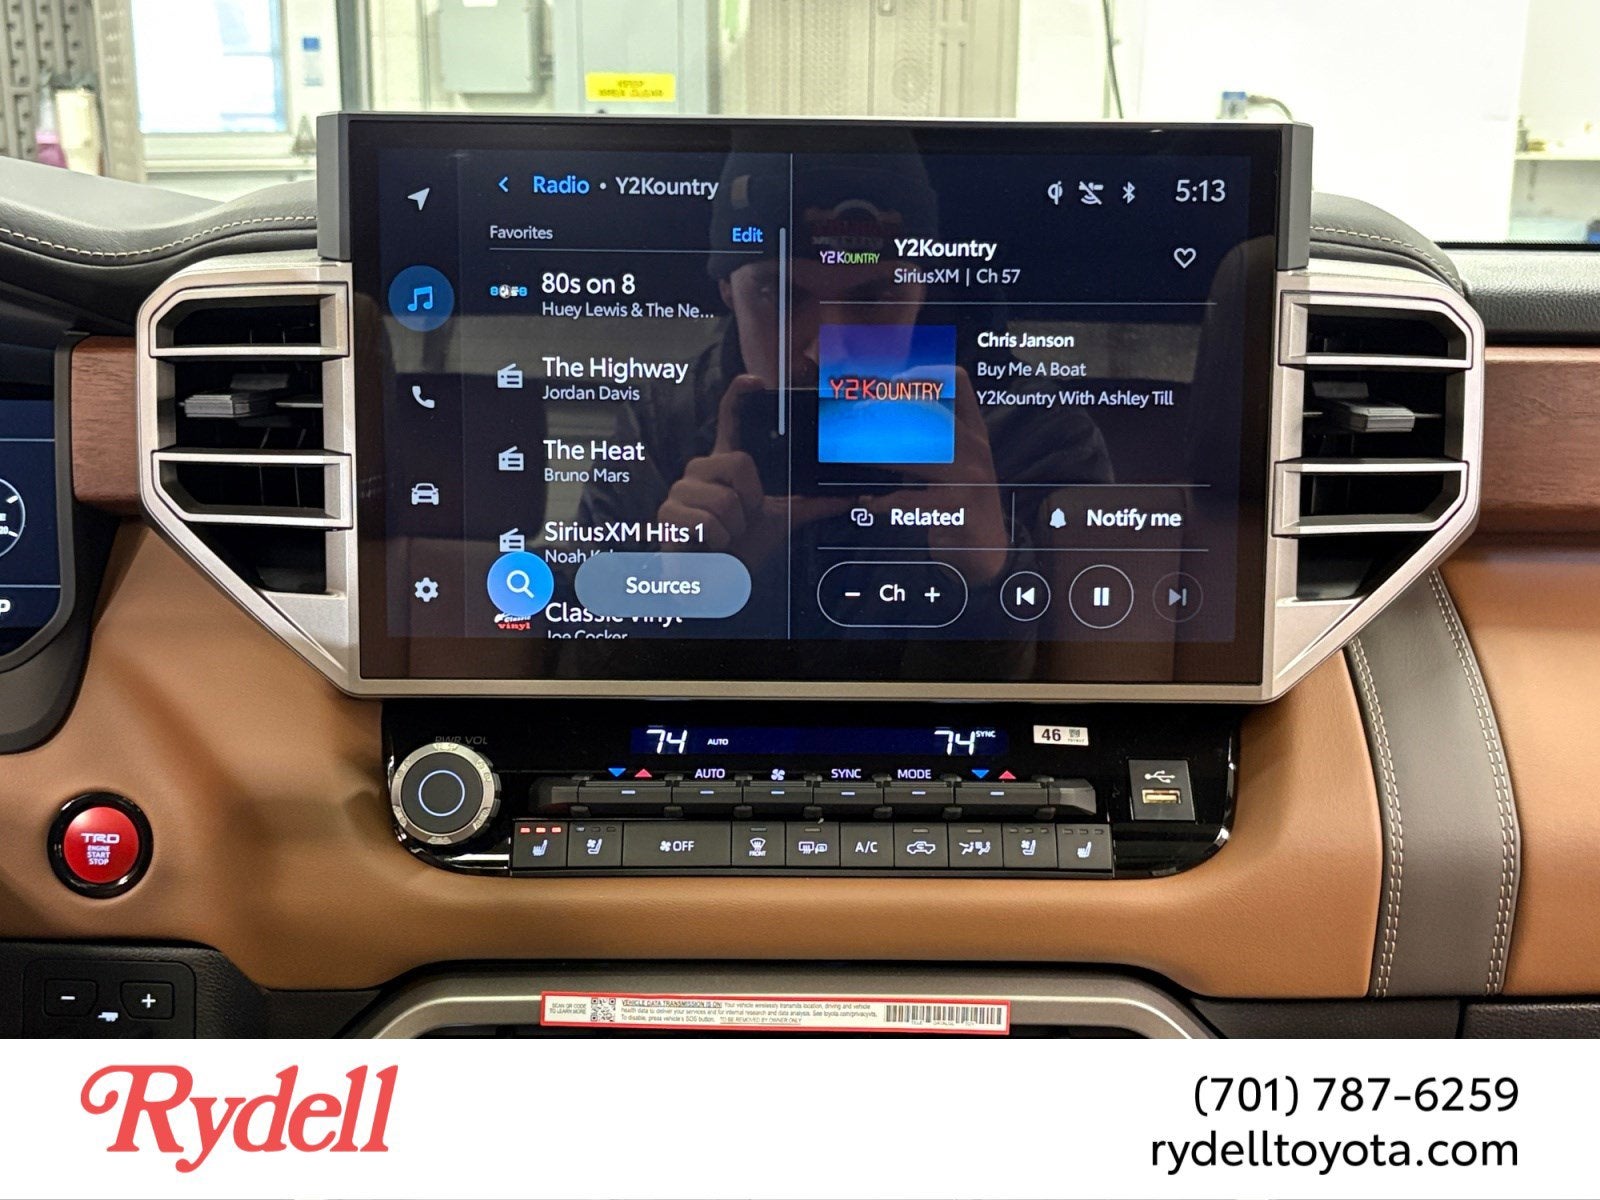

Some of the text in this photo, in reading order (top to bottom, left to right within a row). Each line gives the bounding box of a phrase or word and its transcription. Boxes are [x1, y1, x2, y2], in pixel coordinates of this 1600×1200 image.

[533, 175, 719, 200] Radio Y2Kountry
[1175, 179, 1226, 201] 5:13
[490, 225, 763, 243] Favorites Edit
[820, 250, 880, 264] Y2KOUNTRY
[894, 240, 996, 261] Y2Kountry
[542, 273, 580, 294] 80s
[586, 278, 615, 294] on
[622, 274, 635, 295] 8
[894, 268, 960, 284] SiriusXM
[976, 268, 998, 284] Ch
[1001, 268, 1021, 284] 57
[543, 303, 582, 320] Huey
[586, 303, 627, 318] Lewis
[631, 304, 643, 318] &
[646, 303, 673, 318] The
[977, 333, 1074, 349] Chris Janson
[542, 356, 688, 384] The Highway
[977, 363, 1086, 381] Buy Me A Boat
[542, 386, 640, 401] Jordan Davis
[830, 379, 944, 400] Y2KOUNTRY
[977, 391, 1174, 409] Y2Kountry With Ashley Till
[543, 439, 645, 461] The Heat
[544, 468, 629, 483] Bruno Mars
[890, 509, 964, 526] Related
[1086, 509, 1182, 531] Notify me
[545, 521, 705, 542] SiriusXM Hits 1
[545, 549, 586, 563] Noah
[626, 576, 700, 594] Sources
[879, 585, 905, 601] Ch
[646, 729, 688, 754] 74
[934, 730, 996, 755] 74 SYNC
[1041, 728, 1062, 742] 46
[695, 768, 725, 779] AUTO
[831, 769, 862, 779] SYNC
[898, 769, 931, 779] MODE
[80, 832, 120, 844] TRD
[673, 841, 694, 852] OFF
[855, 841, 878, 854] A/C
